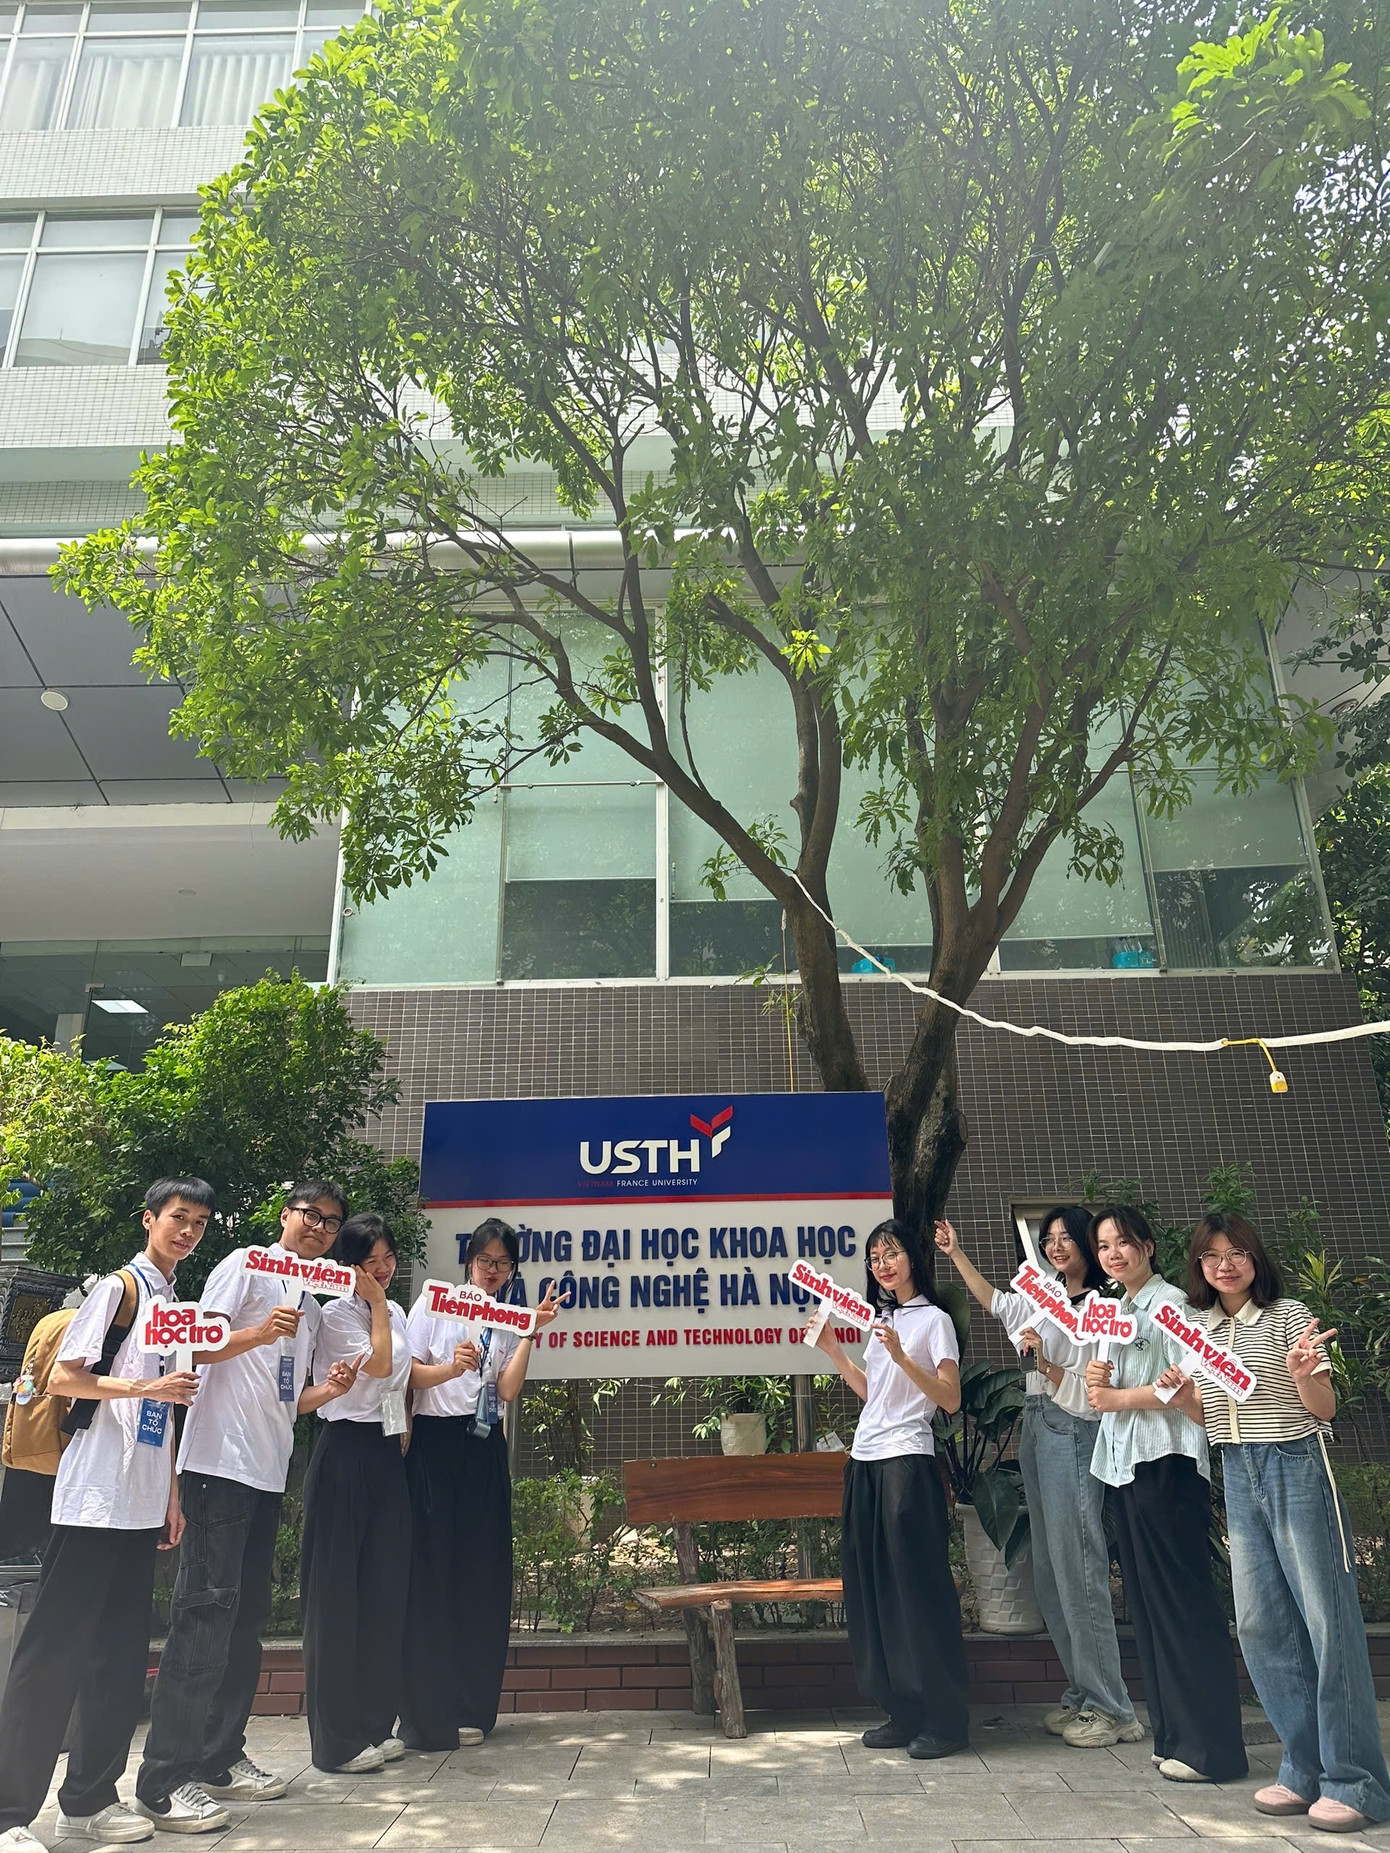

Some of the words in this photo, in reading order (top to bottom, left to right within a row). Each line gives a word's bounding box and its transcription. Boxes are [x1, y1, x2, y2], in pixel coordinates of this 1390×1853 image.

[580, 1138, 700, 1174] USTH
[616, 1179, 649, 1187] FRANCE
[652, 1178, 698, 1187] UNIVERSITY
[581, 1229, 631, 1268] ĐẠI
[641, 1227, 700, 1267] HỌC
[709, 1226, 788, 1258] KHOA
[797, 1225, 856, 1264] HỌC
[459, 1289, 482, 1302] BÁO
[538, 1270, 620, 1309] CÔNG
[630, 1267, 709, 1313] NGHỆ
[719, 1266, 760, 1306] HÀ
[1043, 1281, 1062, 1298] BÁO
[153, 1303, 196, 1327] hoa
[1088, 1297, 1117, 1319] hoa
[549, 1331, 568, 1349] OF
[573, 1330, 640, 1348] SCIENCE
[646, 1329, 678, 1346] AND
[684, 1327, 783, 1345] TECHNOLOGY
[146, 1410, 163, 1420] BAN
